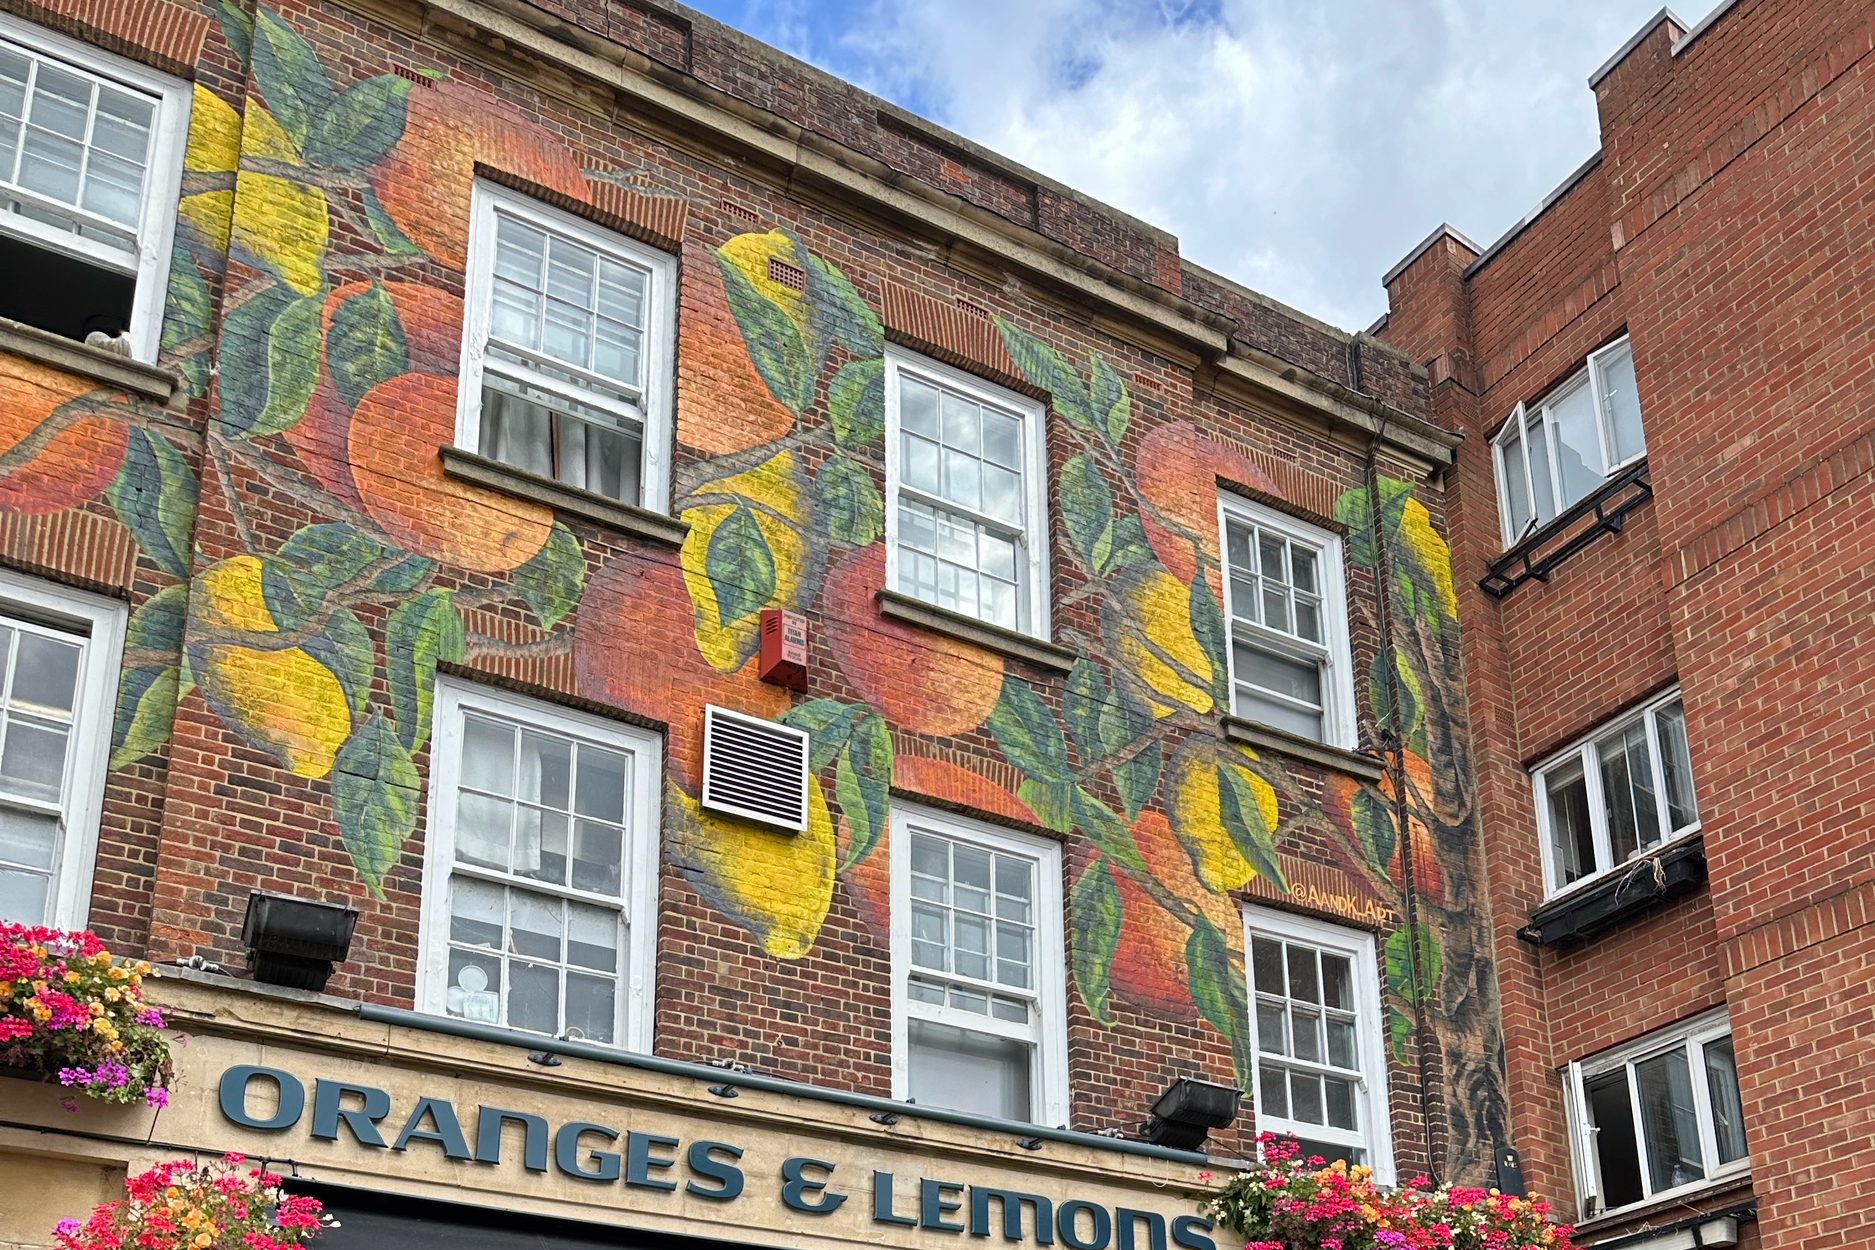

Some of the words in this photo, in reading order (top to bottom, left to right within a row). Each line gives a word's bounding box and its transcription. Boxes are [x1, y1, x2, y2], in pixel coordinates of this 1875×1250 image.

[787, 628, 802, 638] TITAN
[785, 635, 805, 646] ALARMS
[218, 1064, 744, 1200] ORANGES
[782, 1157, 849, 1213] &
